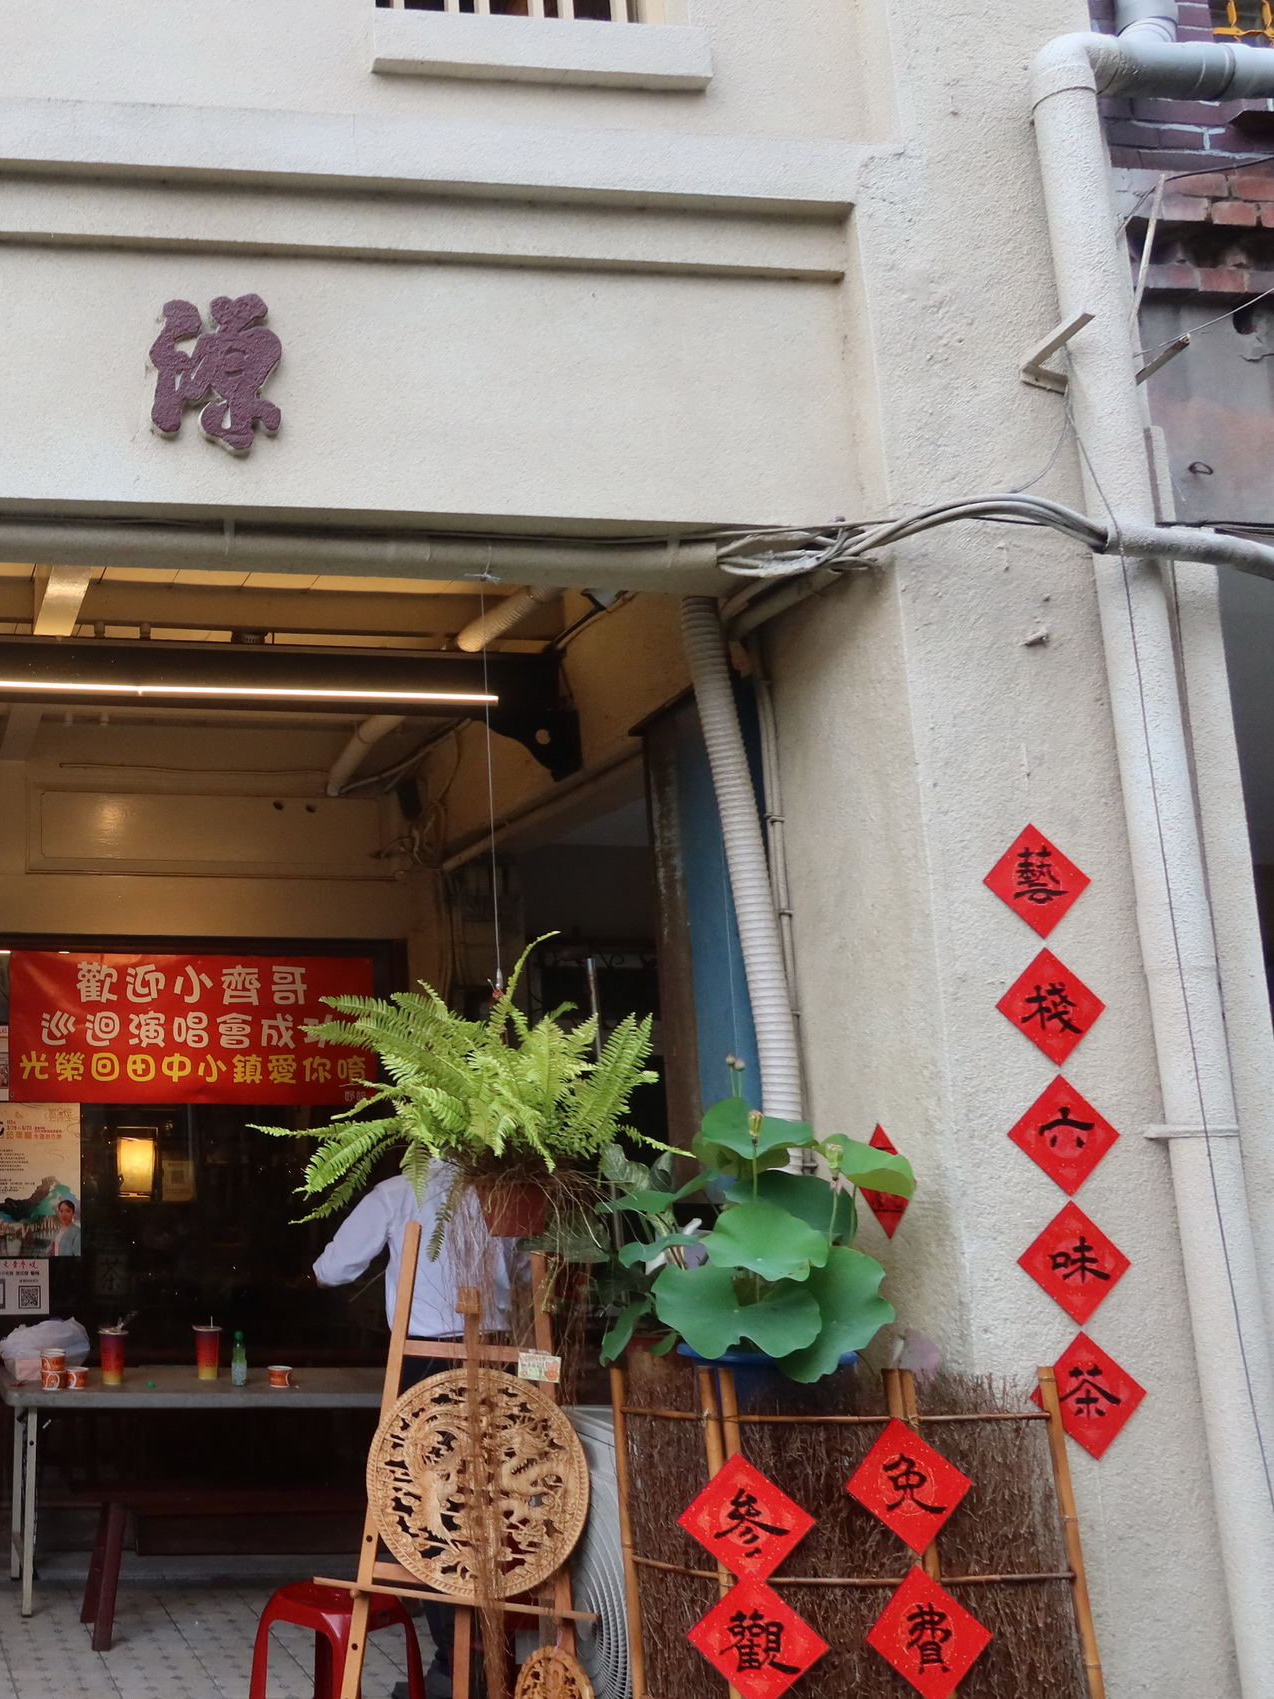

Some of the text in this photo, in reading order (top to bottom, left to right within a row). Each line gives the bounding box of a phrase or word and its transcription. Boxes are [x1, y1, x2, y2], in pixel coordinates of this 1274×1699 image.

[75, 960, 308, 1006] 歡迎小齊哥
